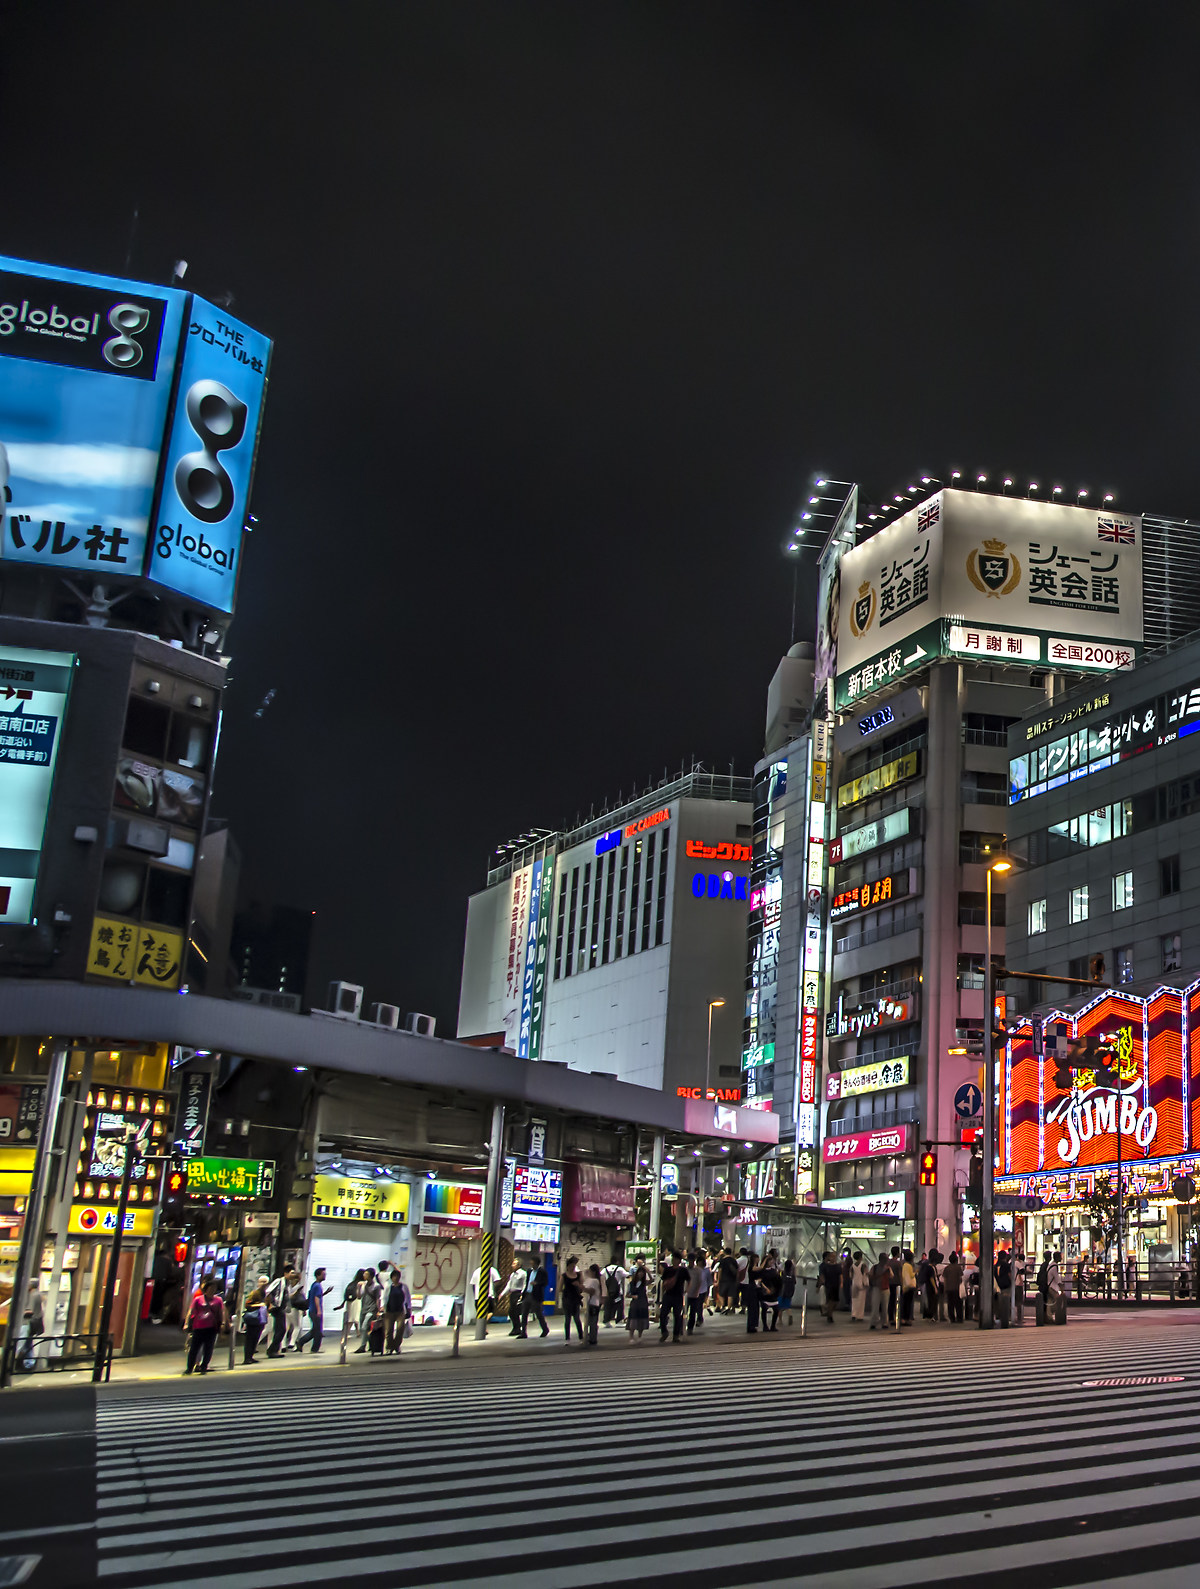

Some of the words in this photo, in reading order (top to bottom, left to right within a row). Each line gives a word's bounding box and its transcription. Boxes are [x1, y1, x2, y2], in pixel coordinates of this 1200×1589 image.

[0, 301, 99, 335] global
[216, 320, 244, 346] THE
[190, 322, 264, 374] グローバル社
[157, 524, 234, 570] global
[1029, 543, 1118, 572] シェーン
[881, 539, 930, 588] シェーン
[880, 564, 929, 617] 英会話
[1029, 567, 1120, 604] 英会話
[965, 633, 1023, 654] 月謝制
[1052, 644, 1131, 666] 全国200校
[848, 649, 901, 697] 新宿本校
[1027, 702, 1092, 740] 品川ステーションビル
[1094, 692, 1110, 711] 新宿
[1039, 715, 1140, 776] インターネット
[1142, 710, 1157, 734] &
[625, 821, 638, 838] BIC
[638, 808, 670, 832] CAMERA
[686, 839, 753, 861] ビックカ
[832, 845, 841, 859] 7F
[692, 872, 751, 900] ODAK
[94, 926, 114, 968] 焼鳥
[113, 926, 132, 976] おでん
[532, 916, 547, 1060] ハルクフー
[803, 1016, 816, 1058] カラオケ
[677, 1087, 701, 1100] BIC
[828, 1077, 840, 1097] 3F
[1046, 1078, 1159, 1162] JUMBO
[827, 1138, 859, 1157] カラオケ
[869, 1137, 884, 1151] BIG
[883, 1133, 901, 1148] ECHO
[90, 1162, 146, 1179] 餃子の亭
[187, 1162, 257, 1191] 思い出横丁
[868, 1200, 899, 1215] カラオケ
